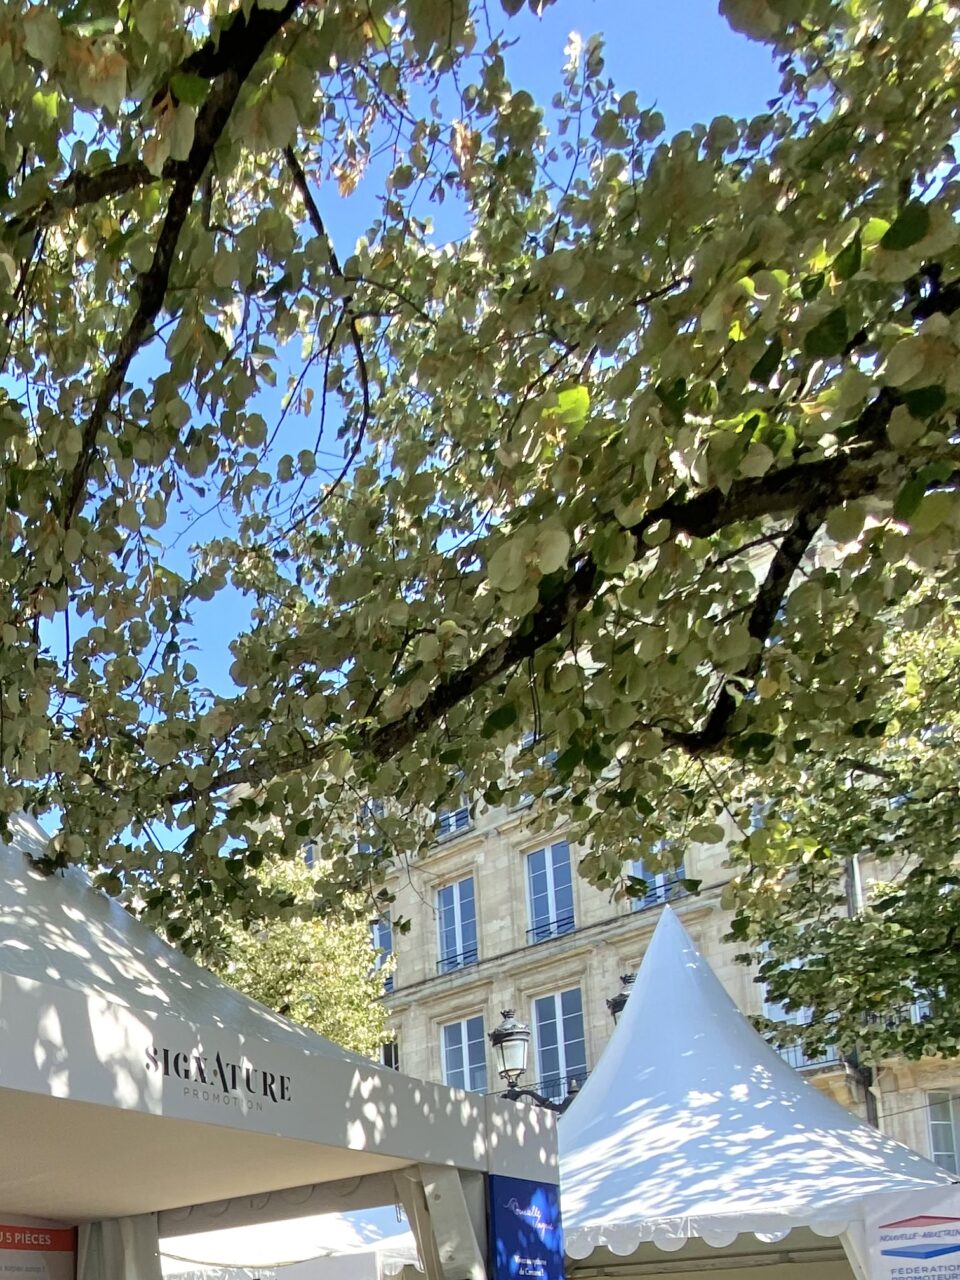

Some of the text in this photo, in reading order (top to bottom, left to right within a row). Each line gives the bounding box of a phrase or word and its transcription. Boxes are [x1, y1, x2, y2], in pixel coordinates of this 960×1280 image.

[145, 1047, 291, 1103] SIGNATURE
[6, 1233, 12, 1243] 5
[14, 1231, 51, 1245] PIÈCES
